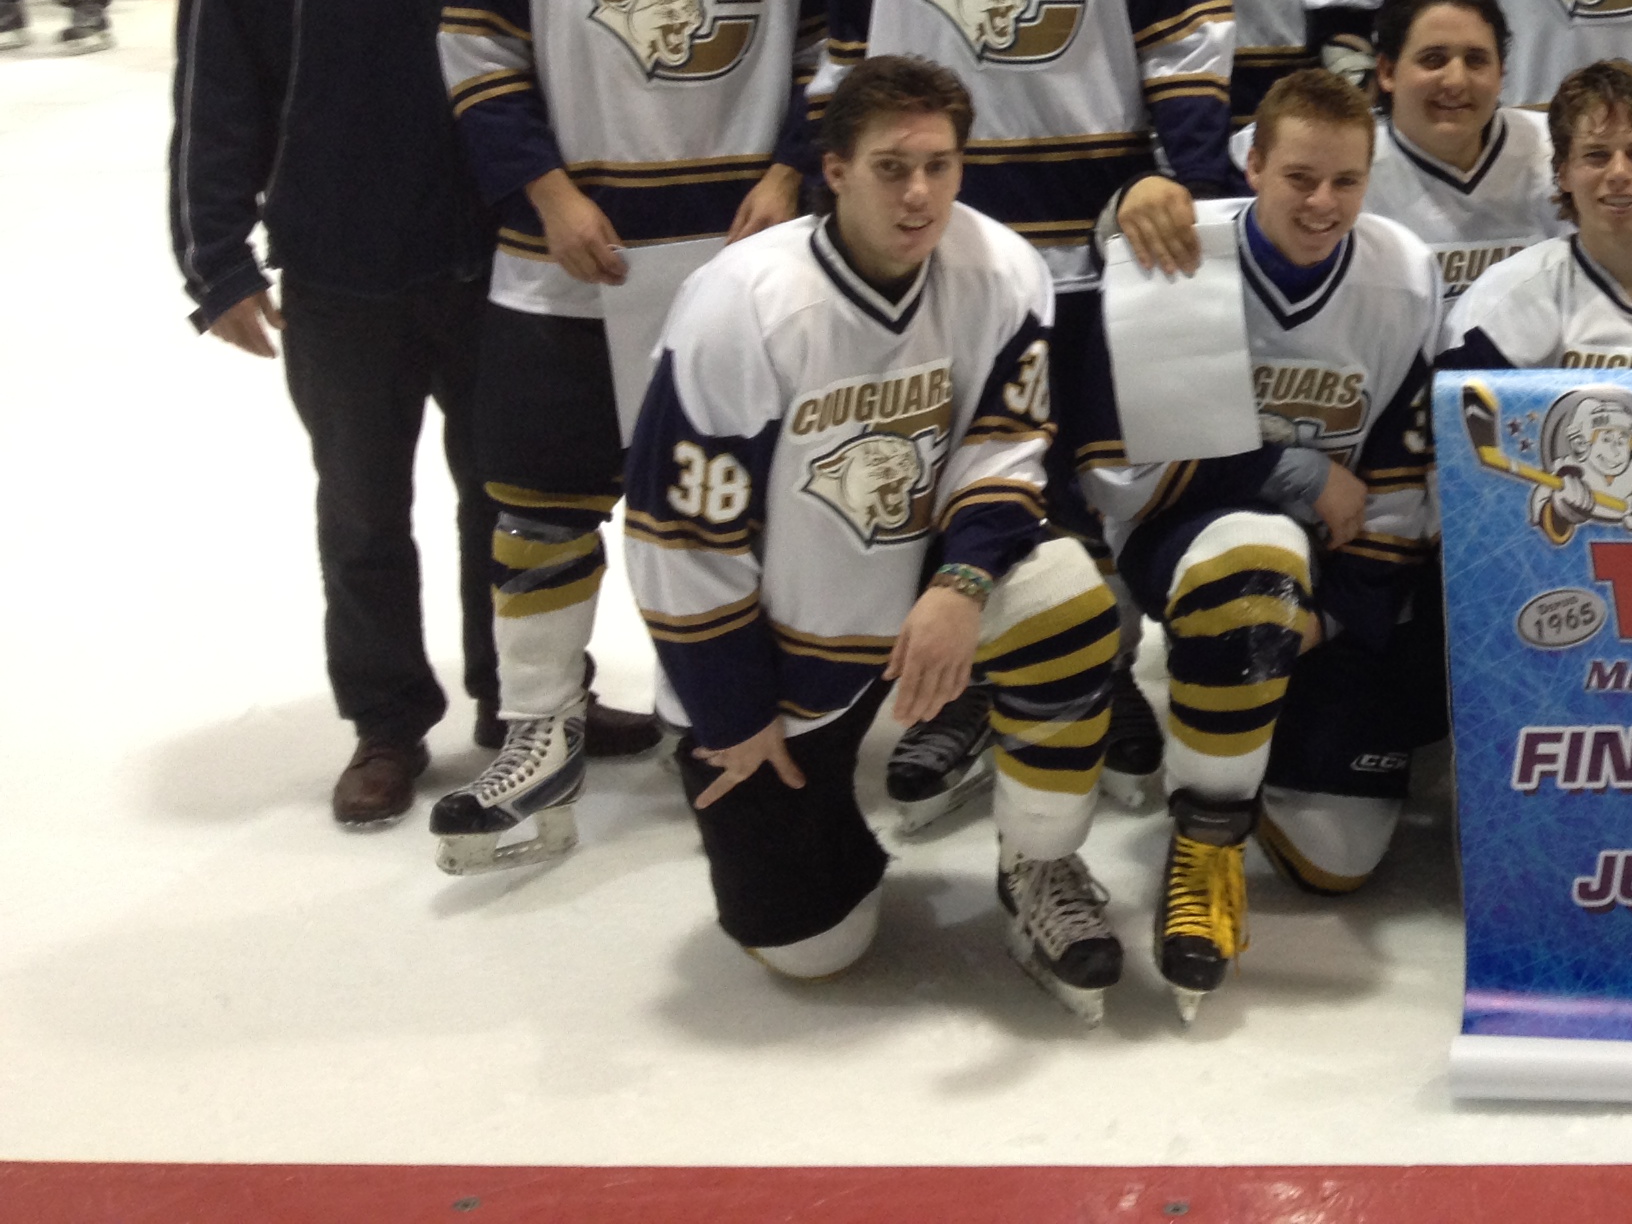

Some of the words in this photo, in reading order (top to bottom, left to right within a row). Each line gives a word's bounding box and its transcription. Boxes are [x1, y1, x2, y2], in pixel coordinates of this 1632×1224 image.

[1252, 365, 1361, 407] GUARS
[668, 440, 751, 524] 38
[1533, 601, 1597, 639] 1965
